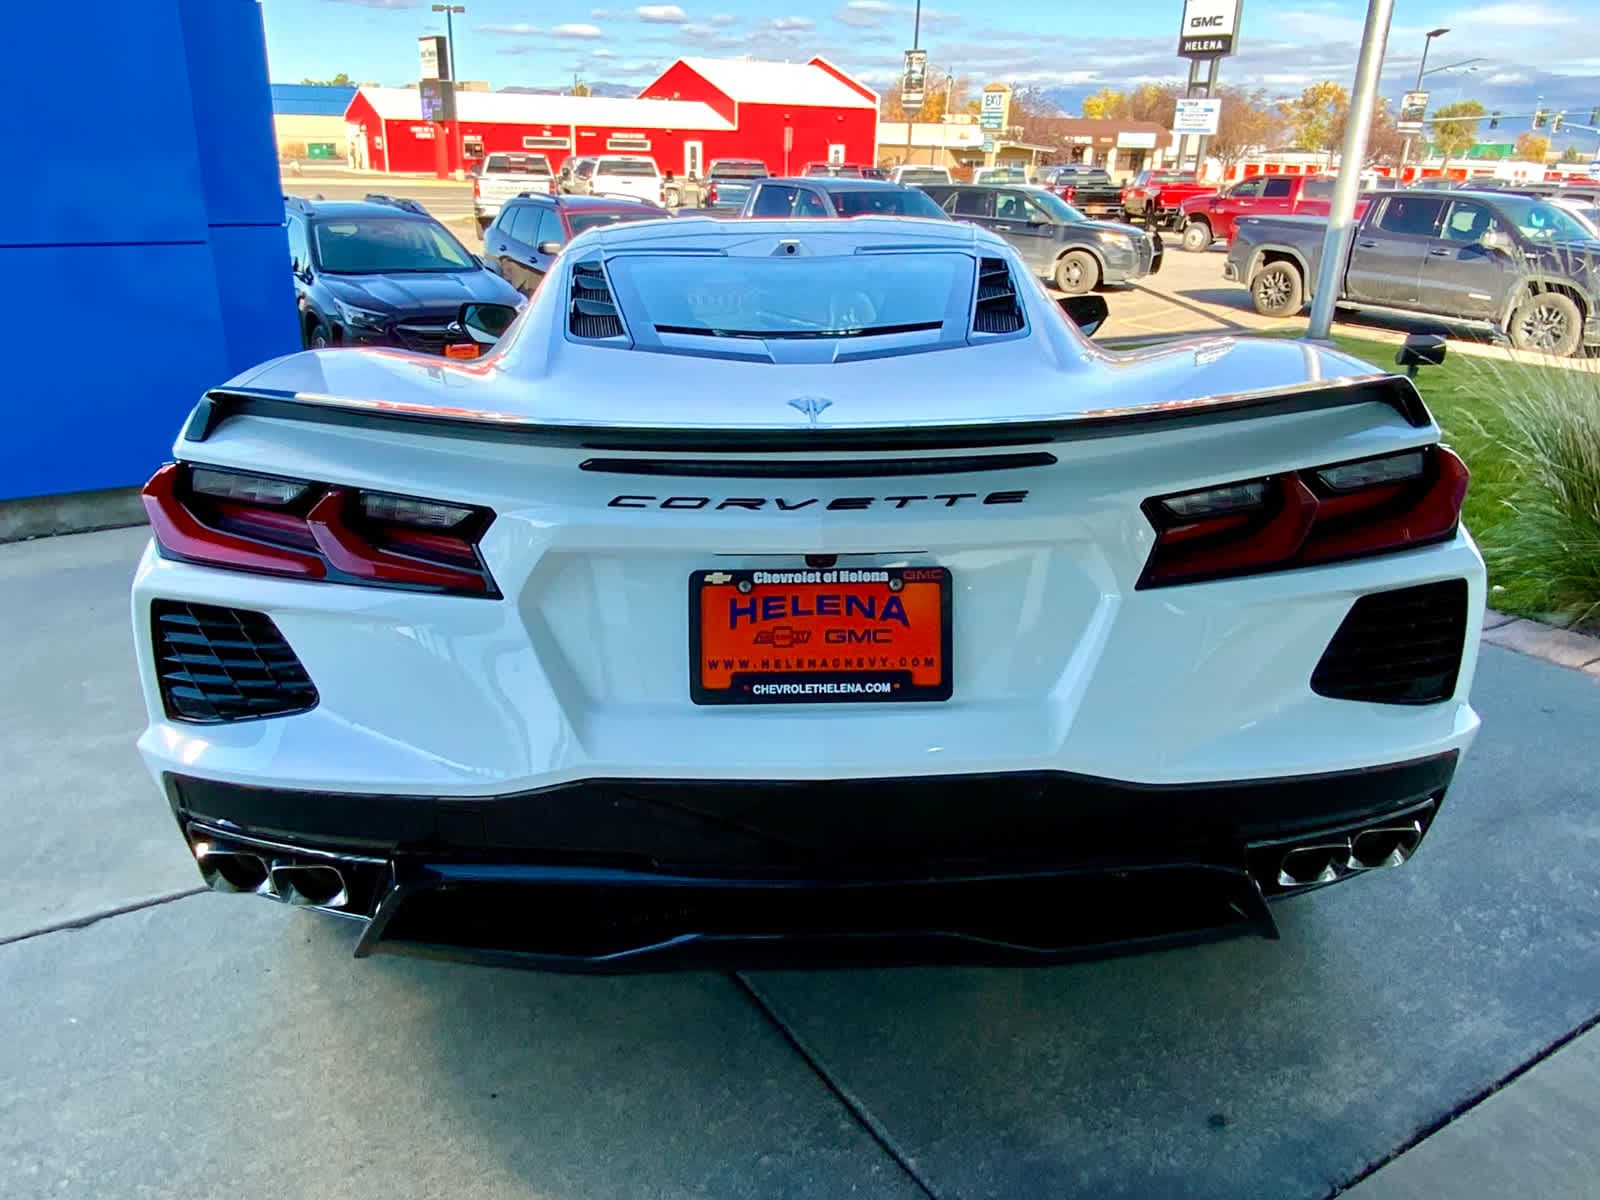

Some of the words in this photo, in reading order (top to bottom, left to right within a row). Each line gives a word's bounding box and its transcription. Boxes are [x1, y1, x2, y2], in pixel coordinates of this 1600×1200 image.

[1190, 15, 1224, 28] GMC
[1184, 40, 1223, 52] HELENA
[985, 94, 1003, 107] EXIT
[608, 490, 1029, 510] CORVETTE
[753, 571, 818, 585] Chevrolet
[822, 571, 837, 583] of
[840, 571, 889, 583] Helena
[903, 570, 943, 580] GMC
[729, 595, 910, 629] HELENA
[824, 629, 893, 644] GMC
[707, 657, 935, 670] WWW.HELENACHEVY.COM
[752, 682, 892, 695] CHEVROLETHELENA.COM
